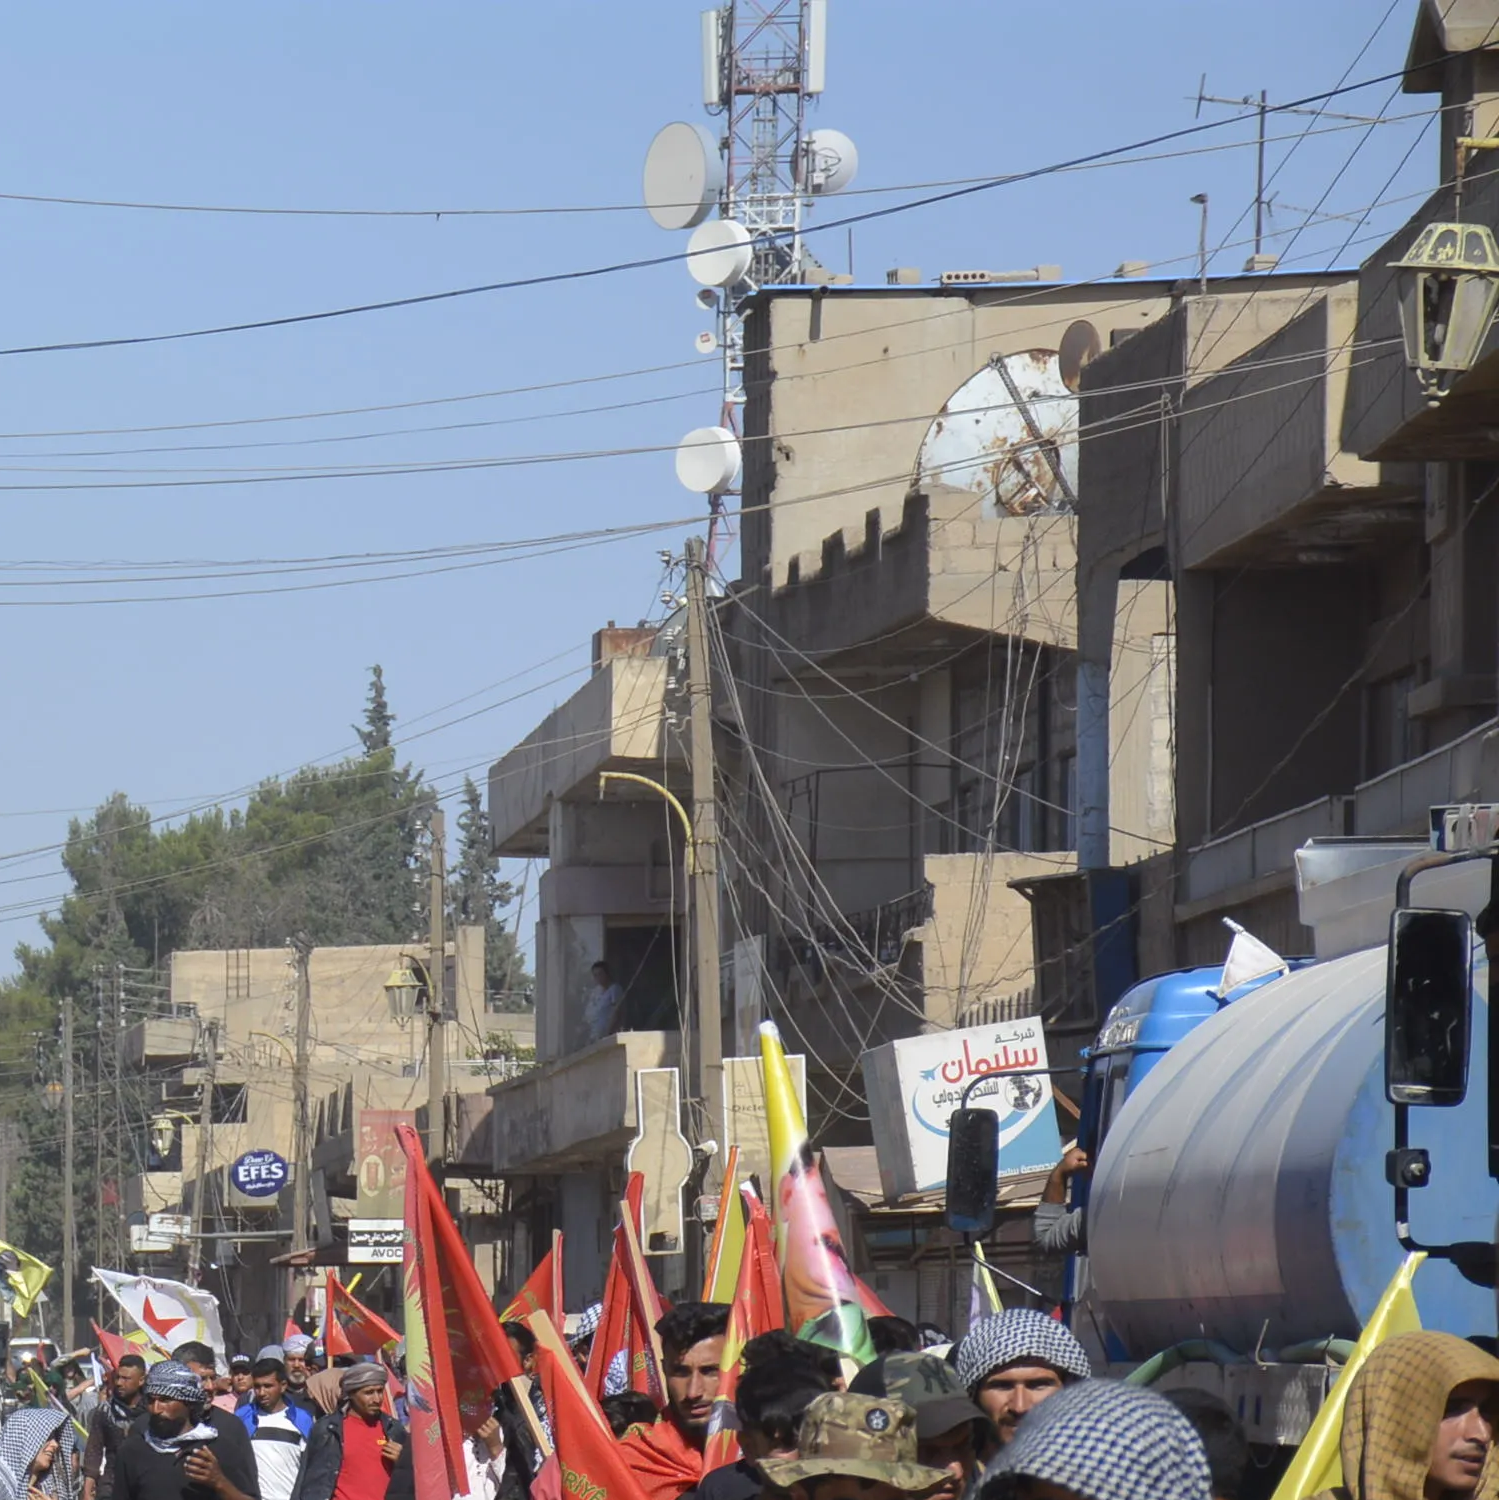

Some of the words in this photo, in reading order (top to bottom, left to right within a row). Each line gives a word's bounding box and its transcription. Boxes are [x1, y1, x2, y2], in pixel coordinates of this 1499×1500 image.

[994, 1027, 1035, 1044] شركة
[941, 1039, 1039, 1084] سليمان
[238, 1163, 284, 1182] EFES
[371, 1248, 402, 1258] AVOC
